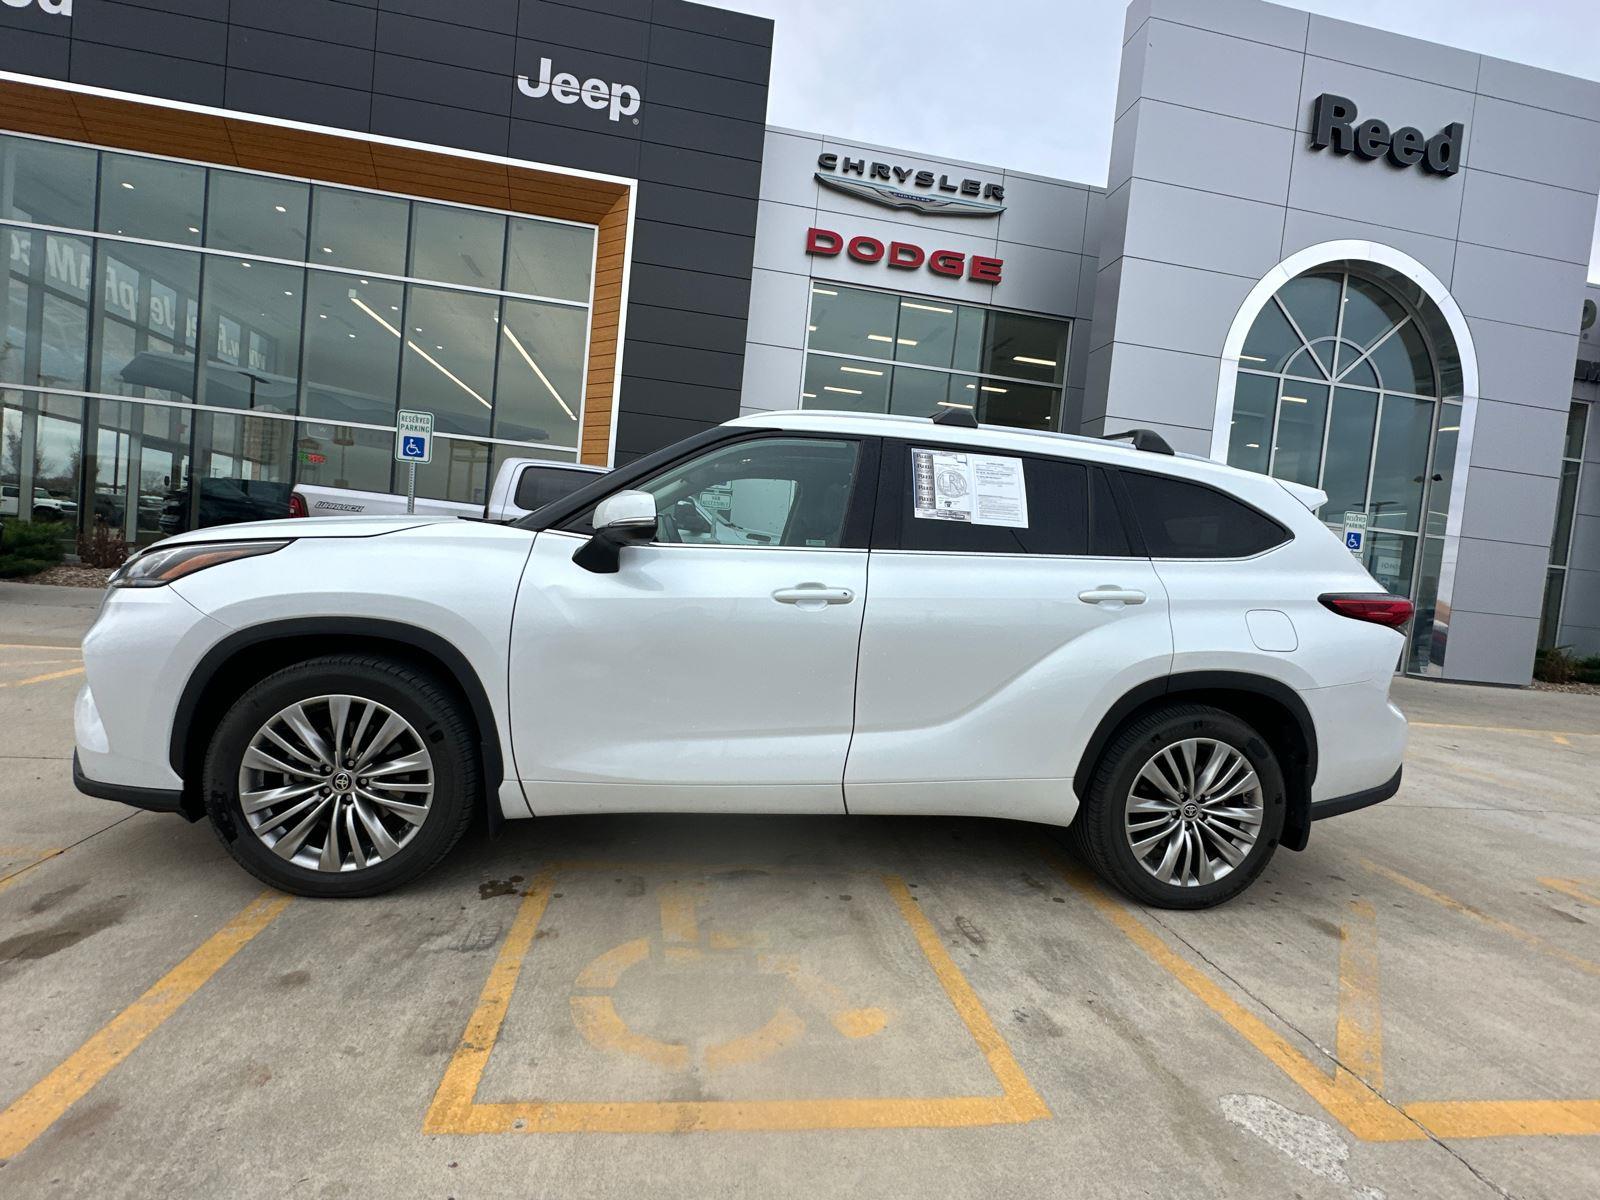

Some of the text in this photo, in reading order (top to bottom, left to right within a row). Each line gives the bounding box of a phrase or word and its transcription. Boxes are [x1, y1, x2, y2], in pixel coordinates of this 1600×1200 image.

[517, 57, 641, 122] Jeep
[1311, 93, 1465, 177] Reed
[818, 153, 1005, 200] CHRYSLER
[806, 227, 1004, 285] DODGE
[400, 423, 430, 434] PARKING
[401, 415, 430, 425] RESERVED
